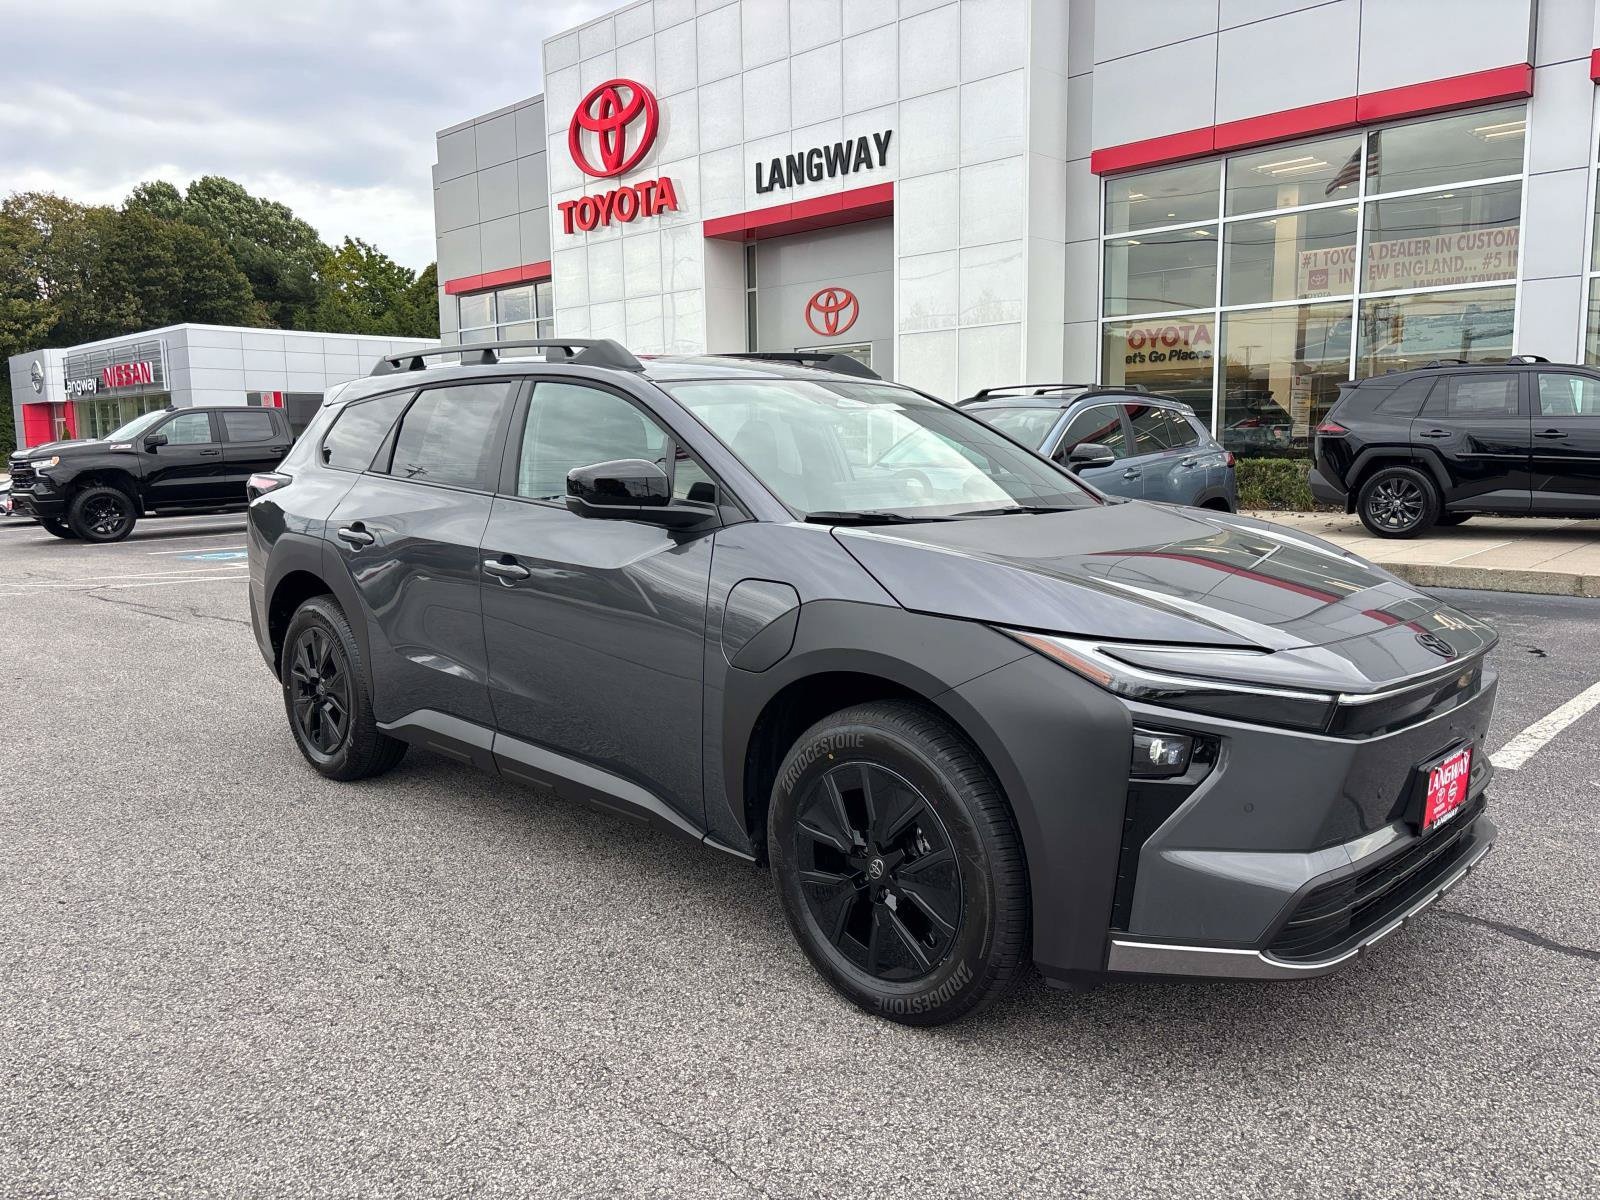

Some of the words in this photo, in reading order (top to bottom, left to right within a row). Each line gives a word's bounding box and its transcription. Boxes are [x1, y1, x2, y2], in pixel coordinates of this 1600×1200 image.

[755, 130, 892, 194] LANGWAY
[557, 177, 678, 234] TOYOTA
[1302, 252, 1318, 268] #1
[1323, 246, 1375, 266] TOYOA
[1379, 240, 1431, 259] DEALER
[1435, 237, 1452, 254] IN
[1338, 267, 1353, 284] IN
[1369, 264, 1389, 280] EW
[1393, 256, 1477, 278] ENGLAND...
[1482, 252, 1504, 272] #5
[1125, 325, 1212, 350] OYOTA
[1125, 351, 1147, 364] et's
[1148, 350, 1167, 362] Go
[1168, 349, 1212, 361] Places
[64, 377, 97, 396] Langway
[103, 361, 154, 388] NISSAN
[782, 733, 864, 796] BRIDGESTONE
[1428, 753, 1470, 796] LANGWAY
[874, 959, 974, 1015] BRIDGESTONE
